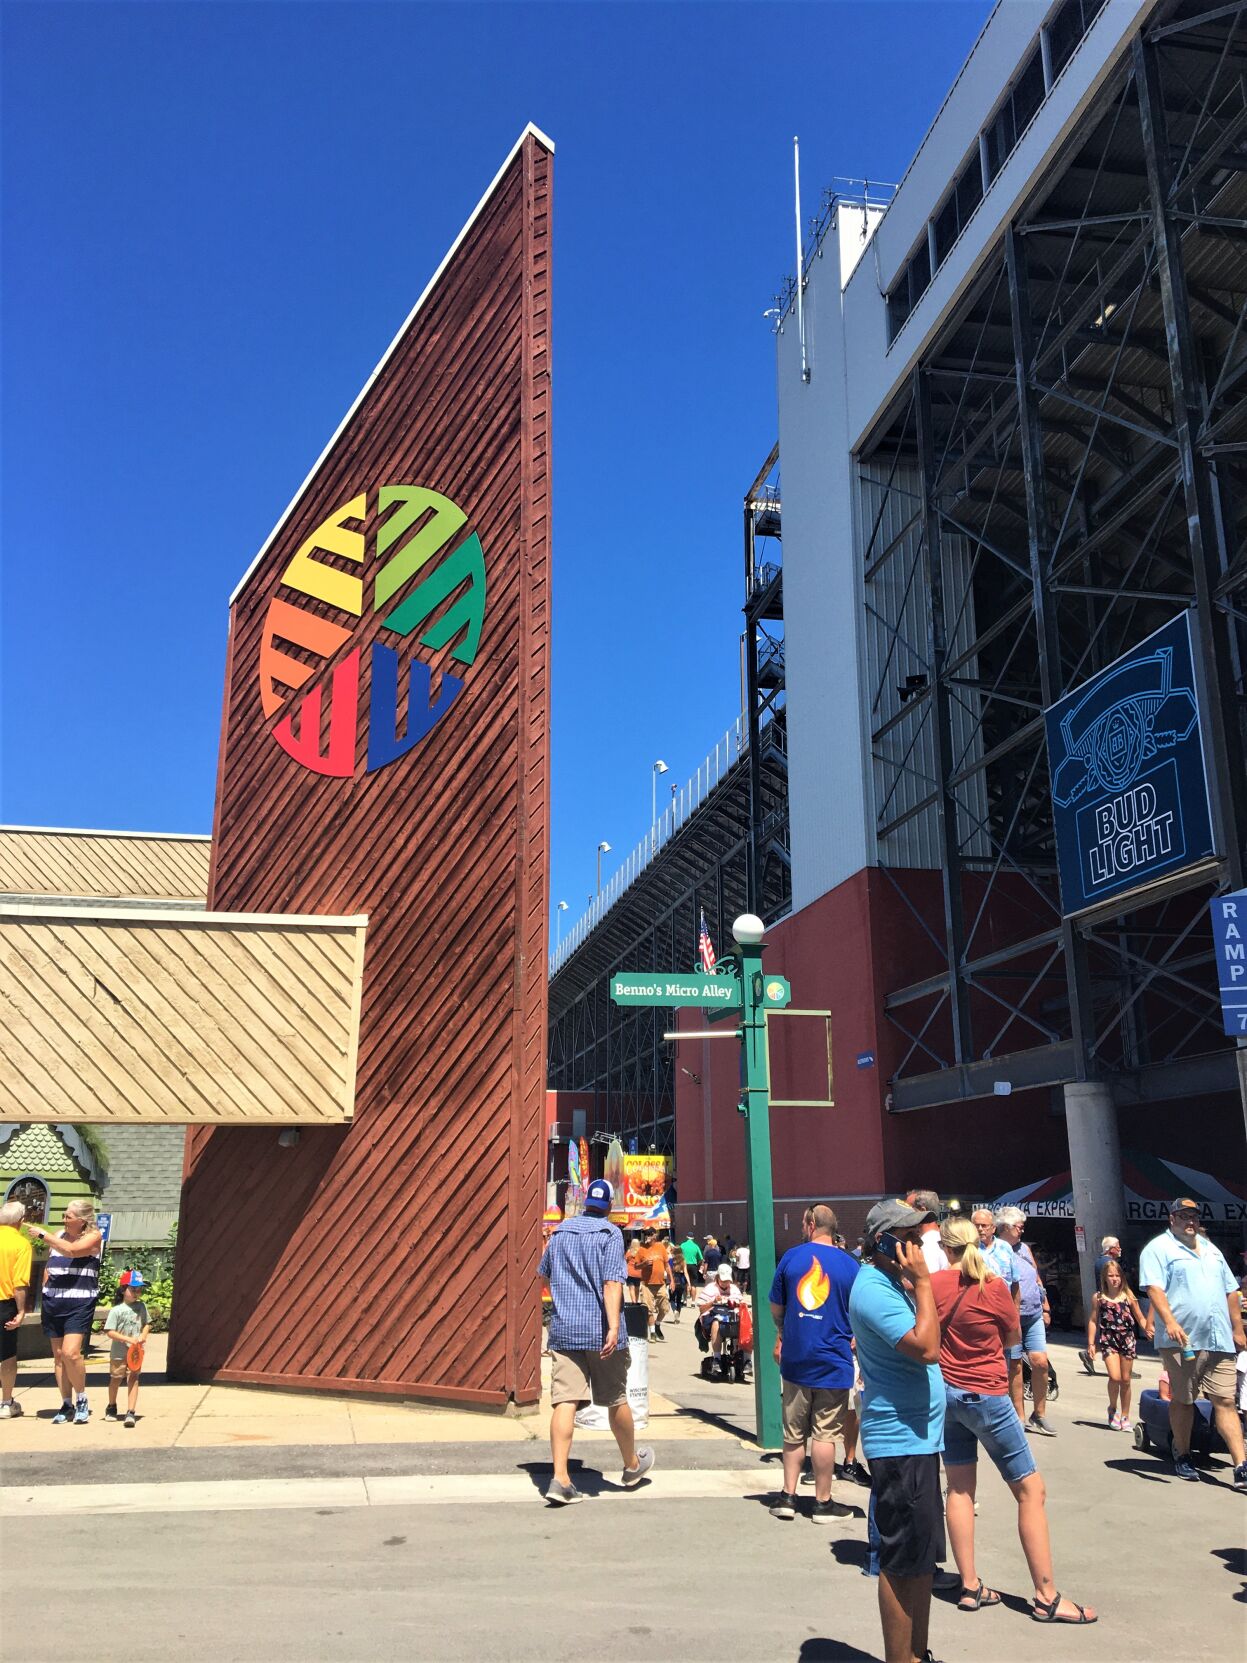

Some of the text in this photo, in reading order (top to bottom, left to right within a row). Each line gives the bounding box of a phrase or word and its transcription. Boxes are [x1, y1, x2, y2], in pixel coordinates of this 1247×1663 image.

[1096, 783, 1157, 844] BUD
[1089, 811, 1173, 885] LIGHT
[1222, 902, 1246, 982] RAMP
[615, 983, 733, 999] Benno's Micro Alley
[1237, 1013, 1247, 1030] 7
